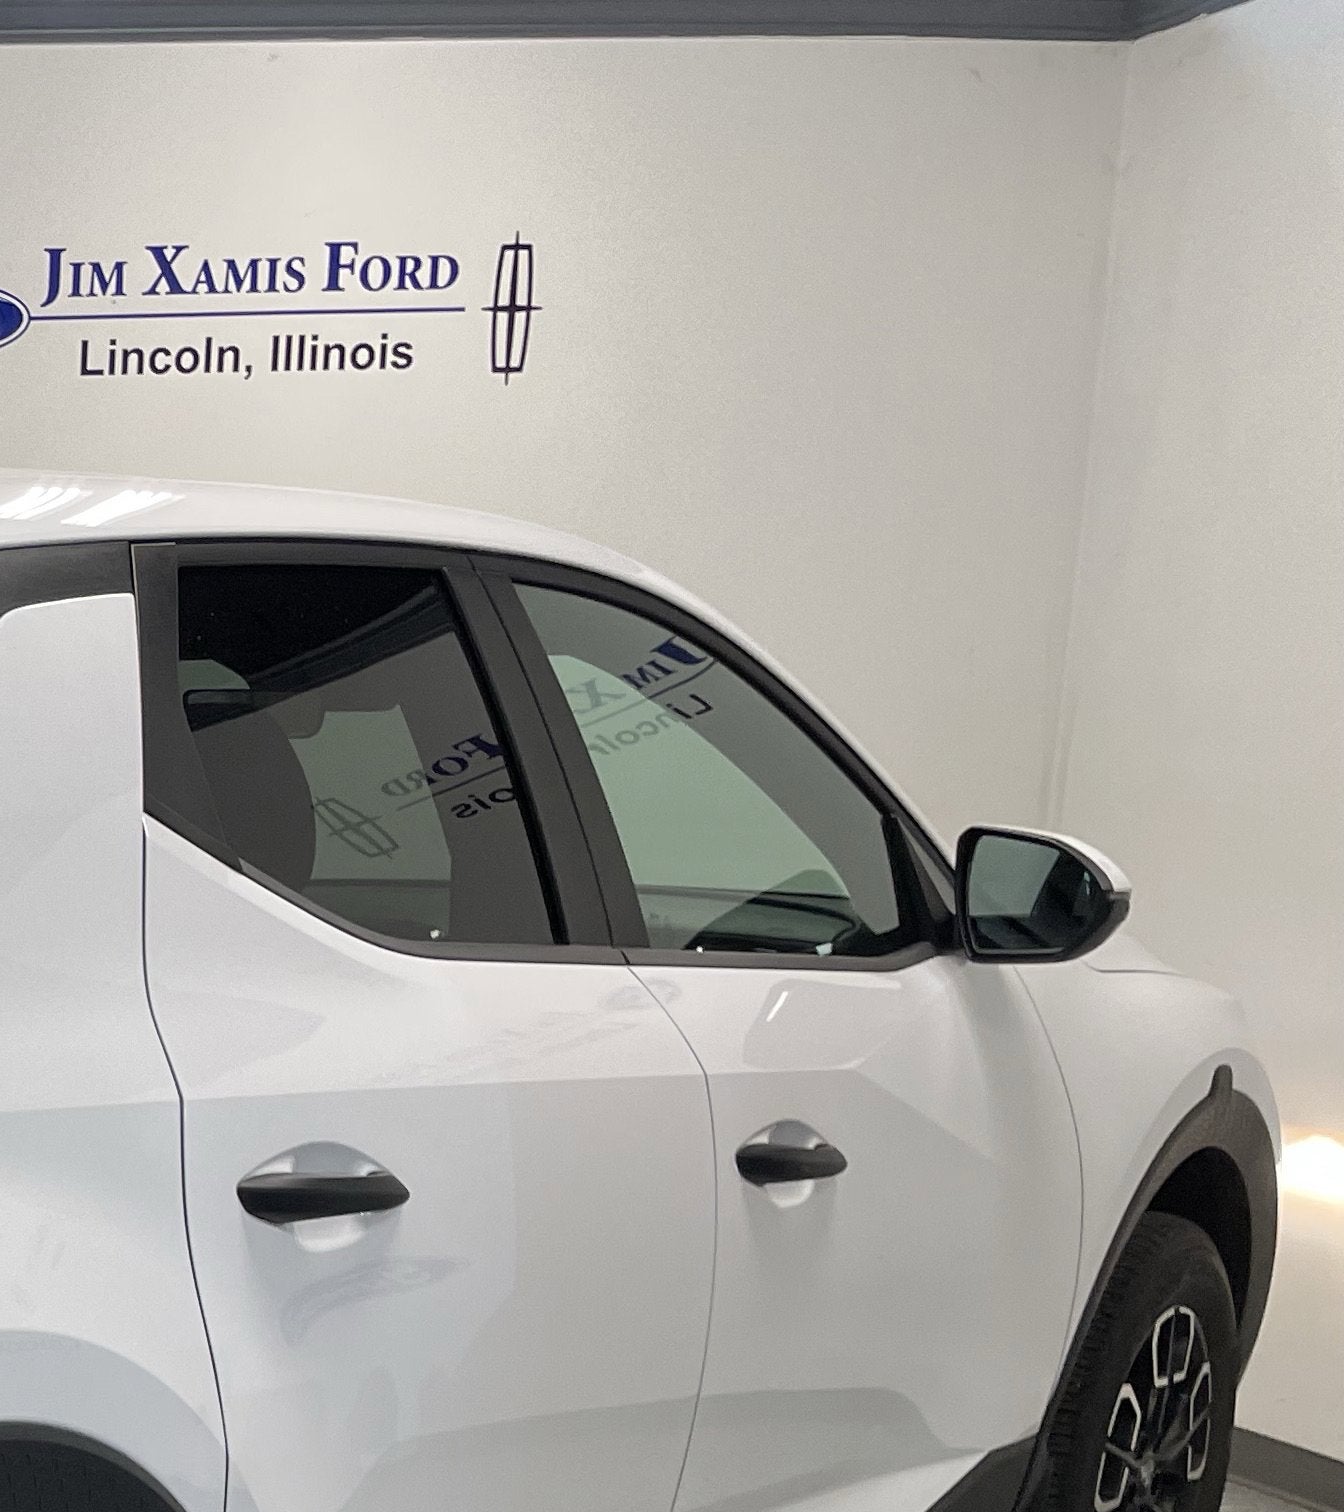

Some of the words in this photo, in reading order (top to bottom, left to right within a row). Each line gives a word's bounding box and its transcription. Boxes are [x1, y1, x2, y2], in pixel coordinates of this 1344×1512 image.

[40, 247, 128, 308] JIM
[141, 245, 307, 297] XAMIS
[321, 241, 460, 293] FORD
[79, 336, 253, 380] Lincoln,
[270, 333, 414, 373] Illinois
